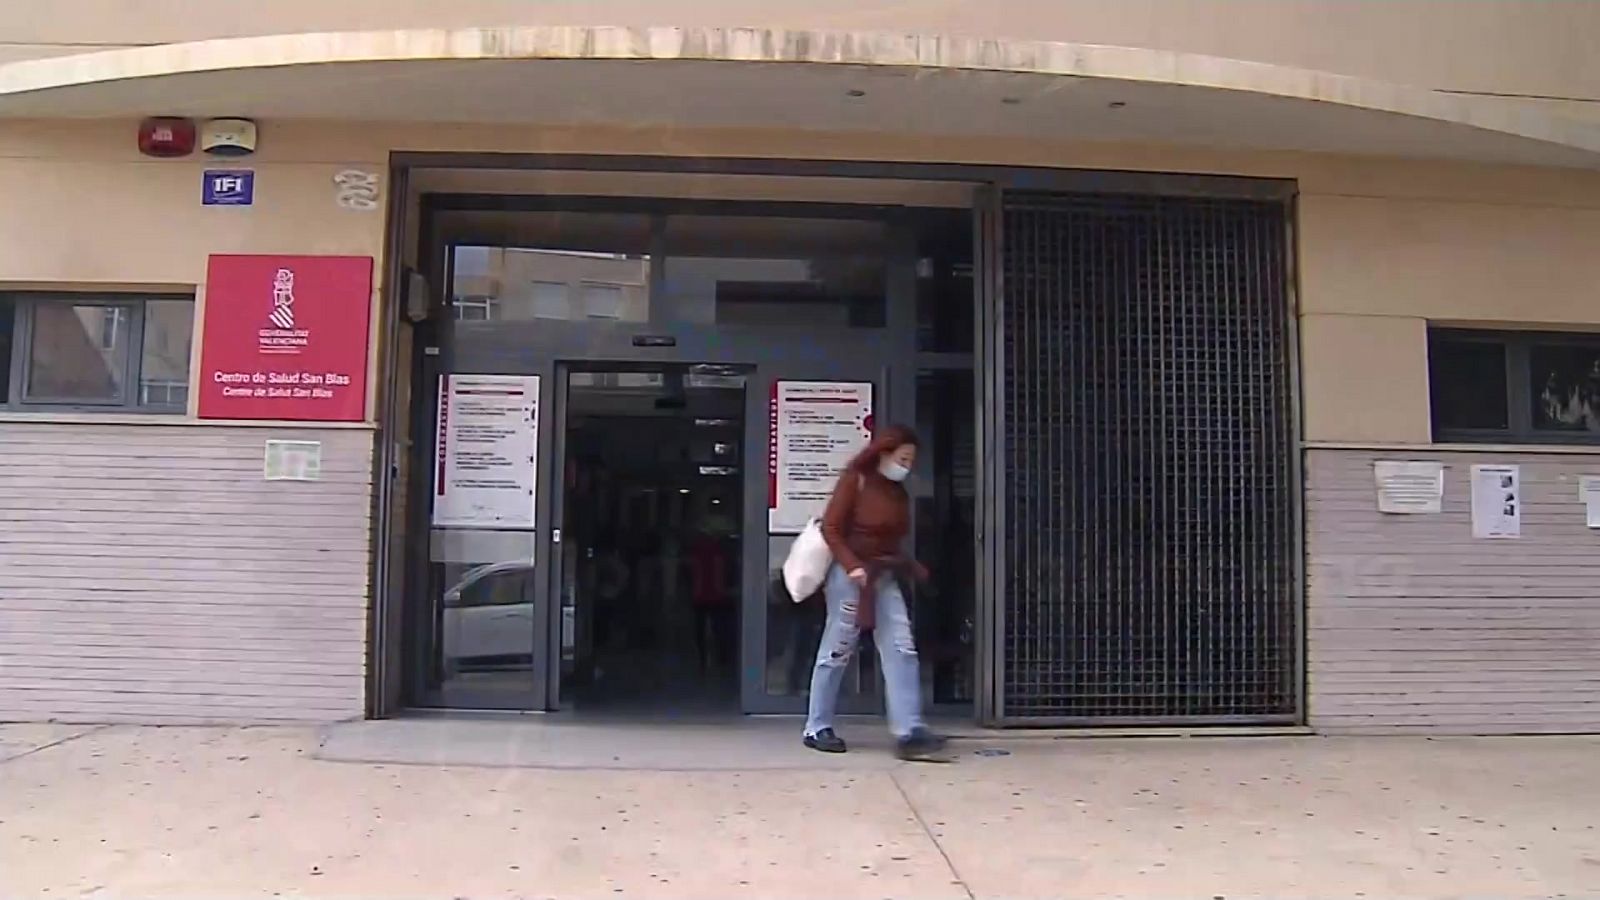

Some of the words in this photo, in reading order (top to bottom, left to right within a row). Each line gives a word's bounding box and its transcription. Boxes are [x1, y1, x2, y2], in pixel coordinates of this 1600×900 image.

[214, 371, 250, 383] Centro
[252, 372, 267, 384] de
[268, 372, 300, 384] Salud
[301, 373, 323, 384] San
[325, 373, 350, 385] Blas
[254, 387, 266, 397] de
[292, 388, 311, 397] San
